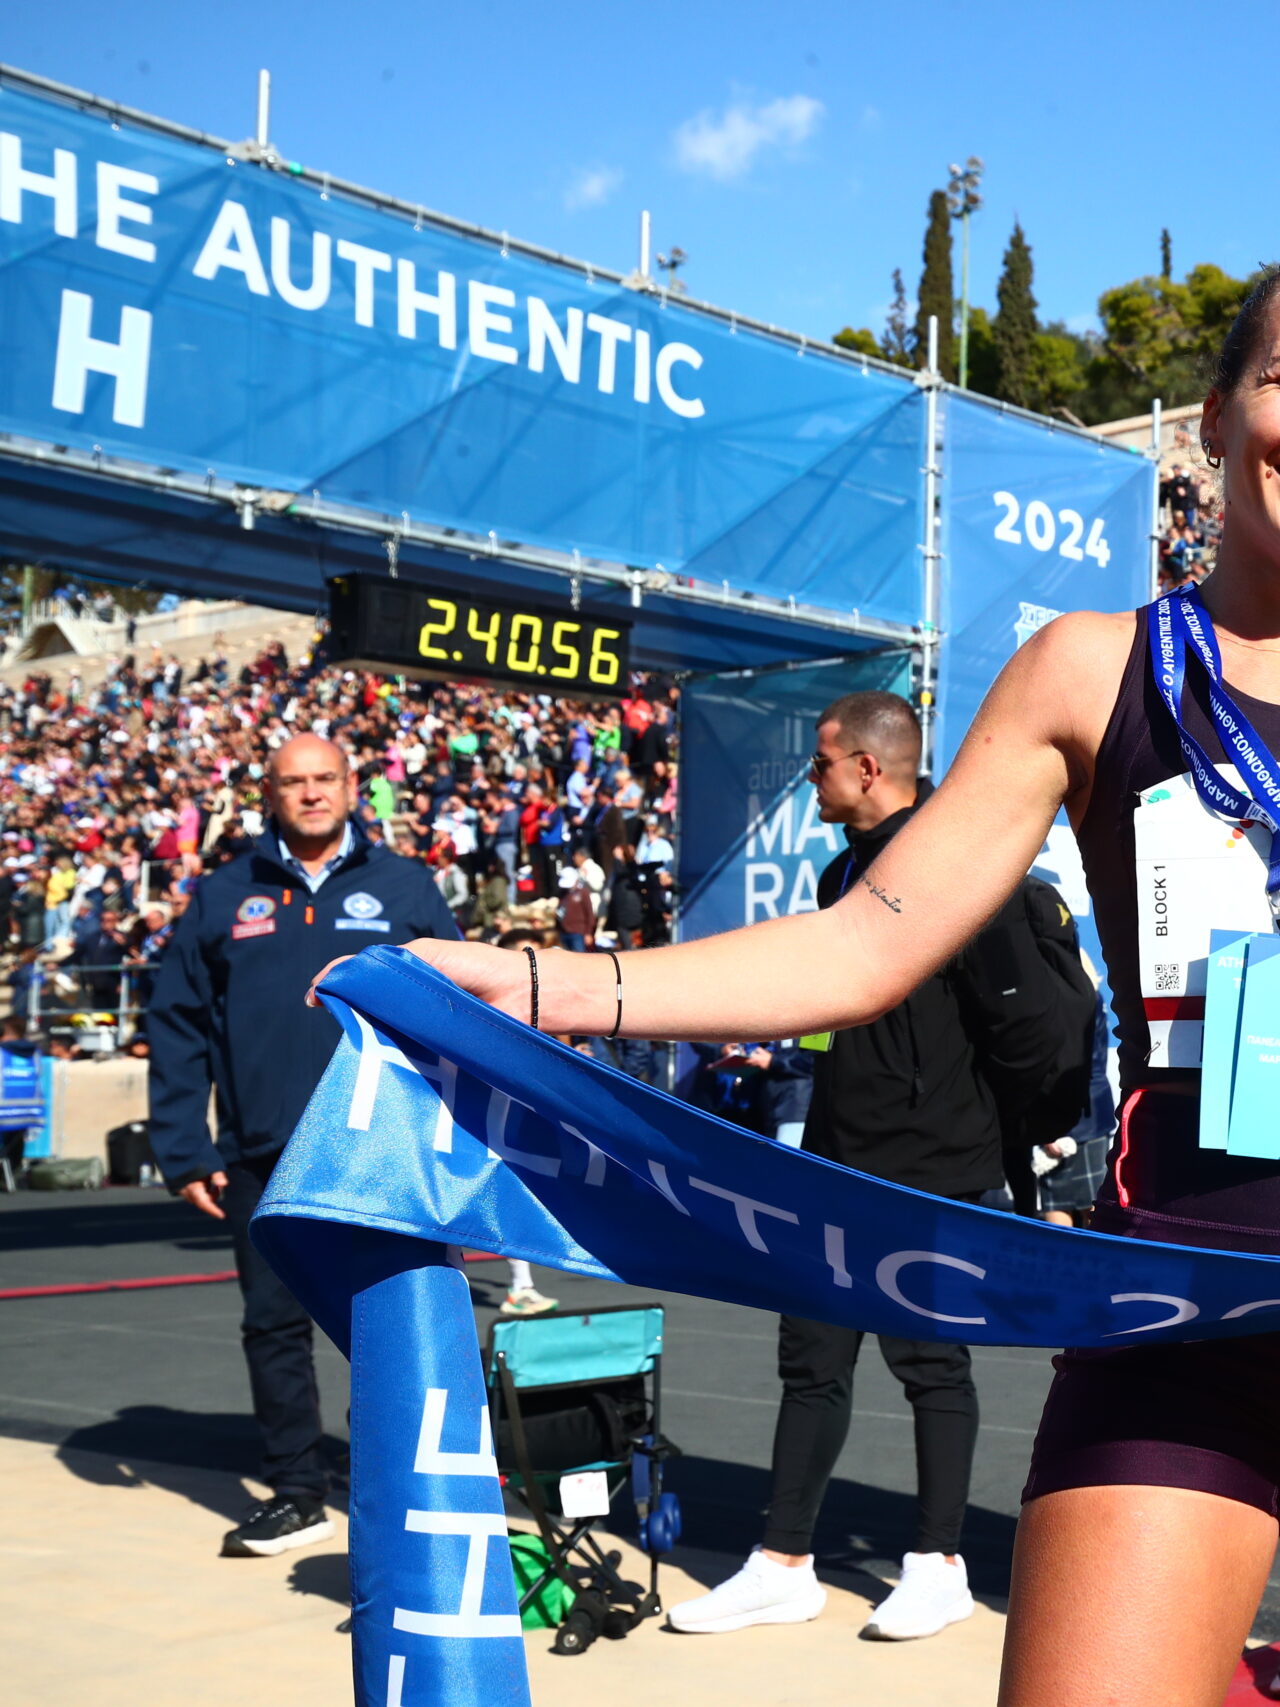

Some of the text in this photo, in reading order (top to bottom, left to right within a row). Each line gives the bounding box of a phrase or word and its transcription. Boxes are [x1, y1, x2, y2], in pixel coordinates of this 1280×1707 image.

[193, 200, 706, 419] AUTHENTIC
[993, 491, 1111, 568] 2024
[418, 598, 621, 686] 2.40.56
[1154, 864, 1169, 937] BLOCK 1
